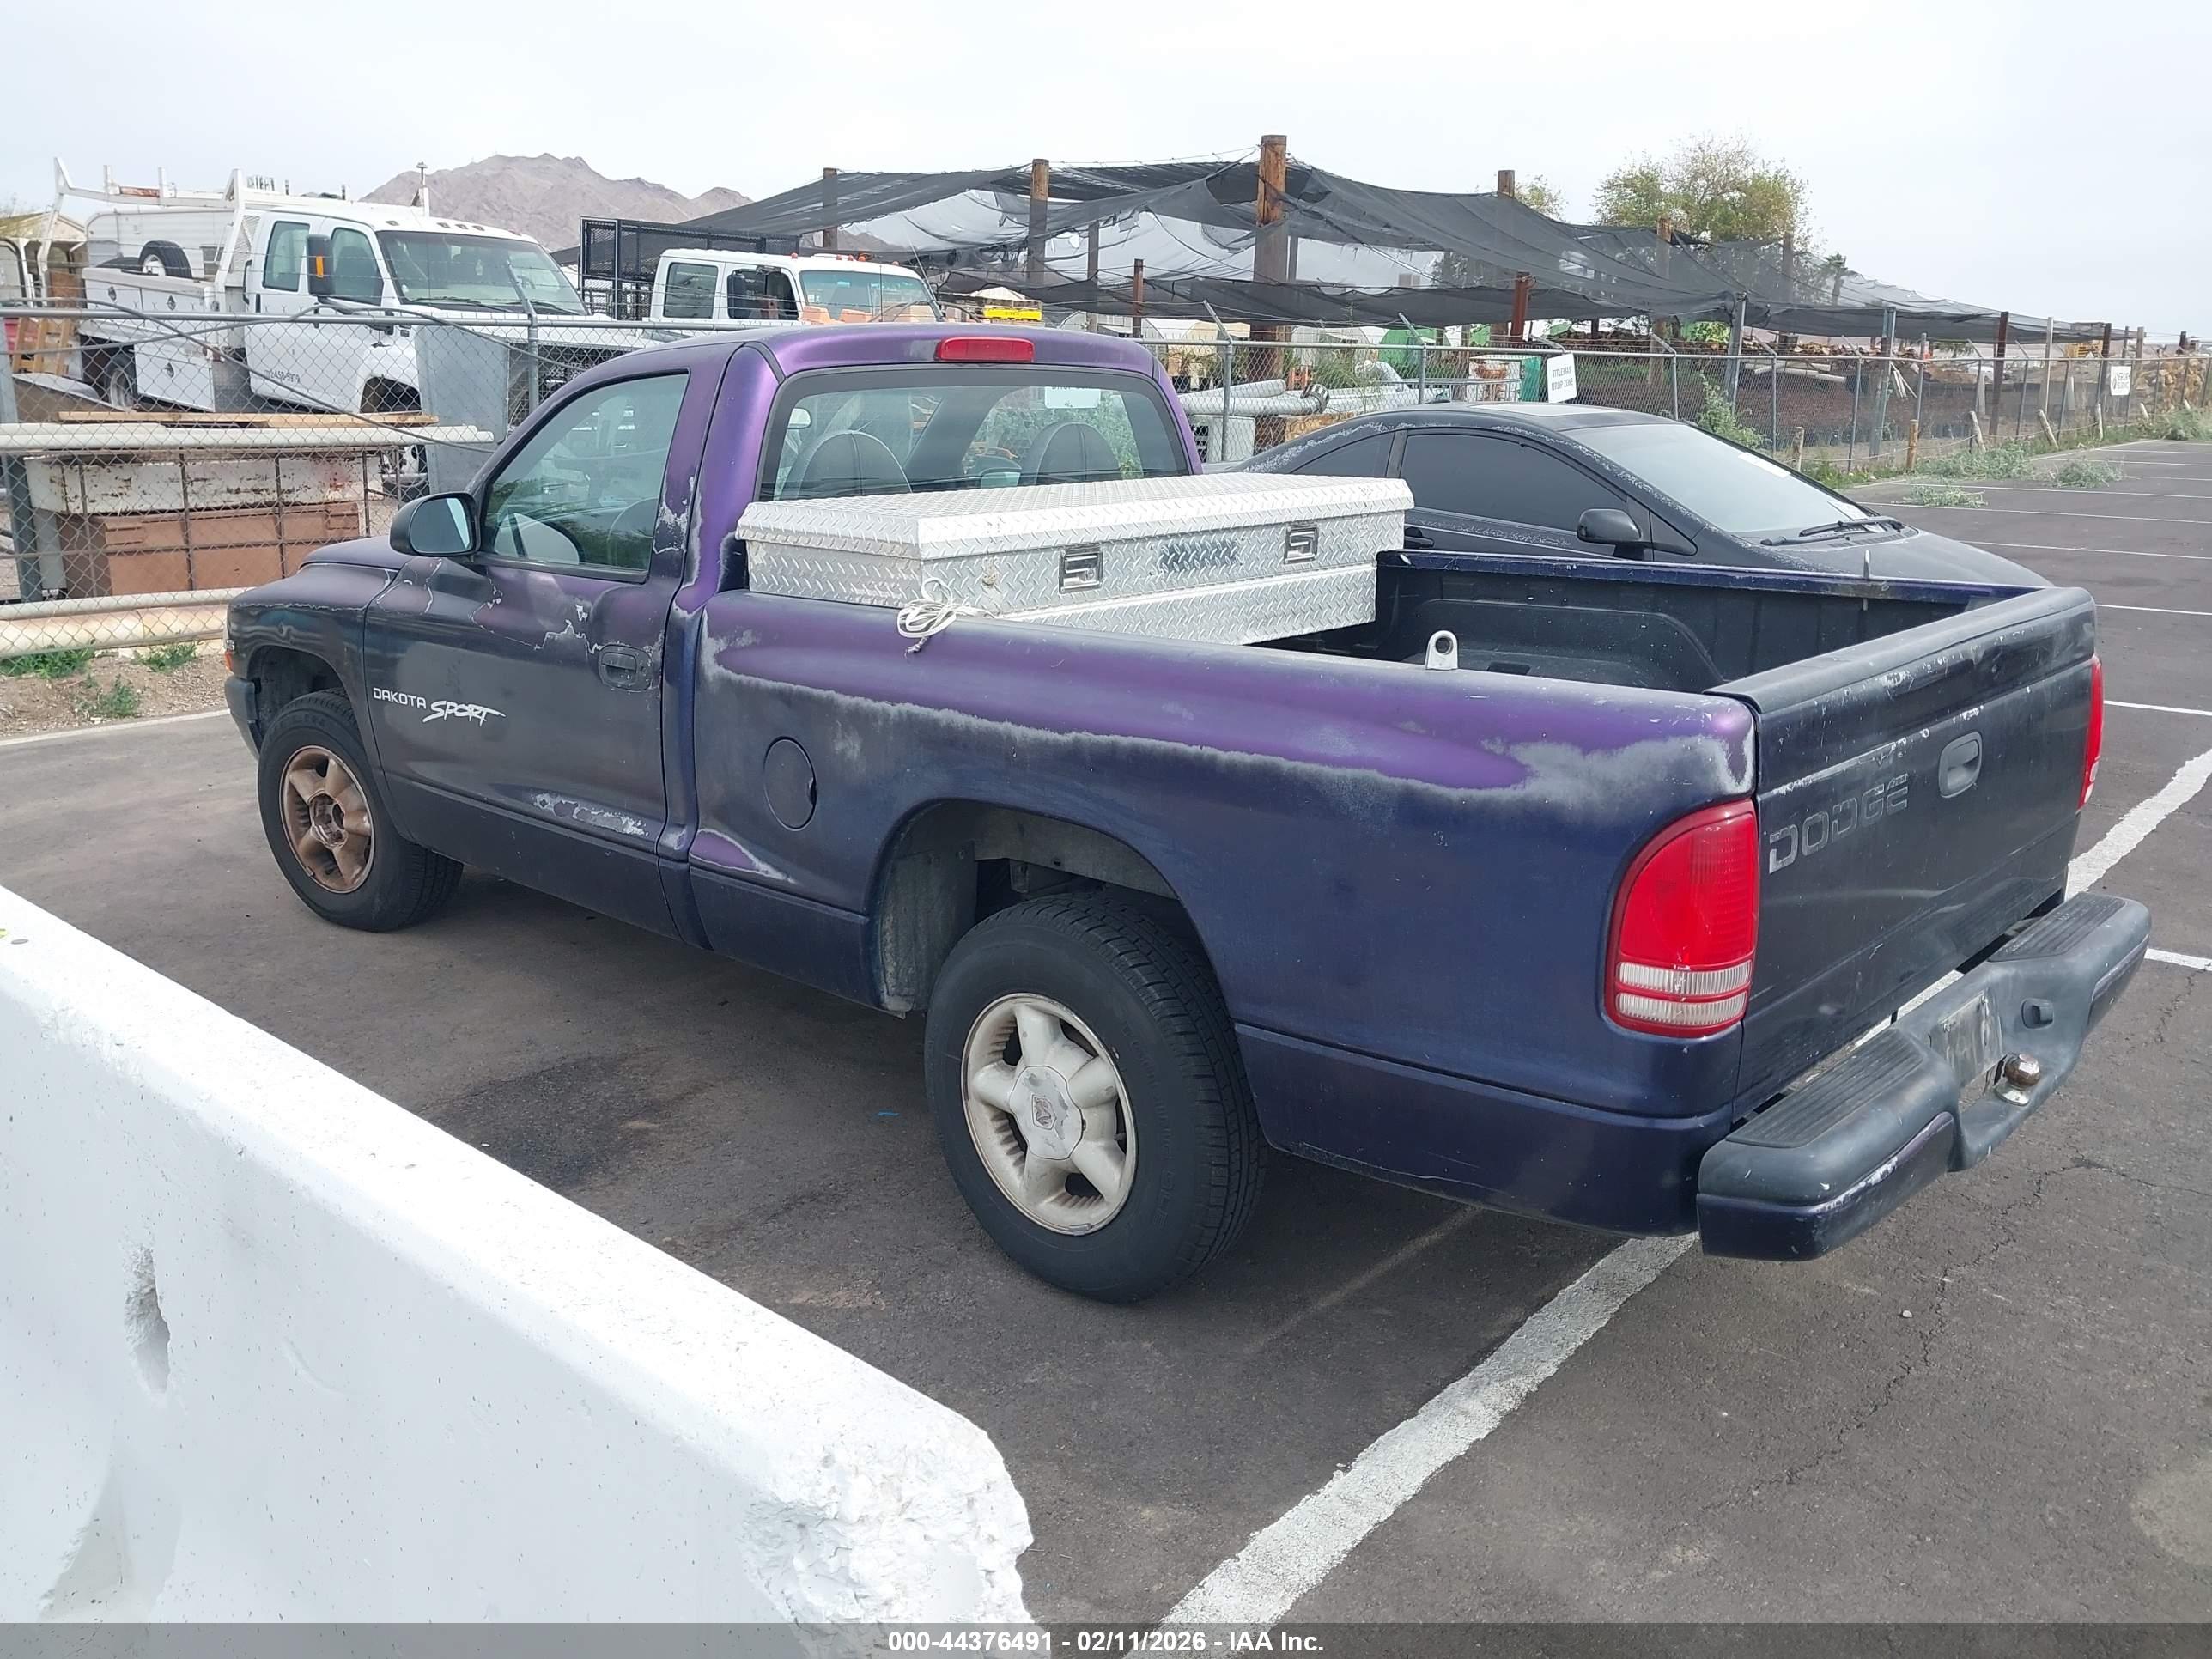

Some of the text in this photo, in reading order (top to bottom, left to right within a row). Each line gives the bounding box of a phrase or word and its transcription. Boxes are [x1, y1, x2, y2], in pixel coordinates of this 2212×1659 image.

[1551, 377, 1574, 391] DROP ZONE
[373, 687, 507, 727] DAKOTA SPORT
[1769, 773, 1909, 874] DODGE
